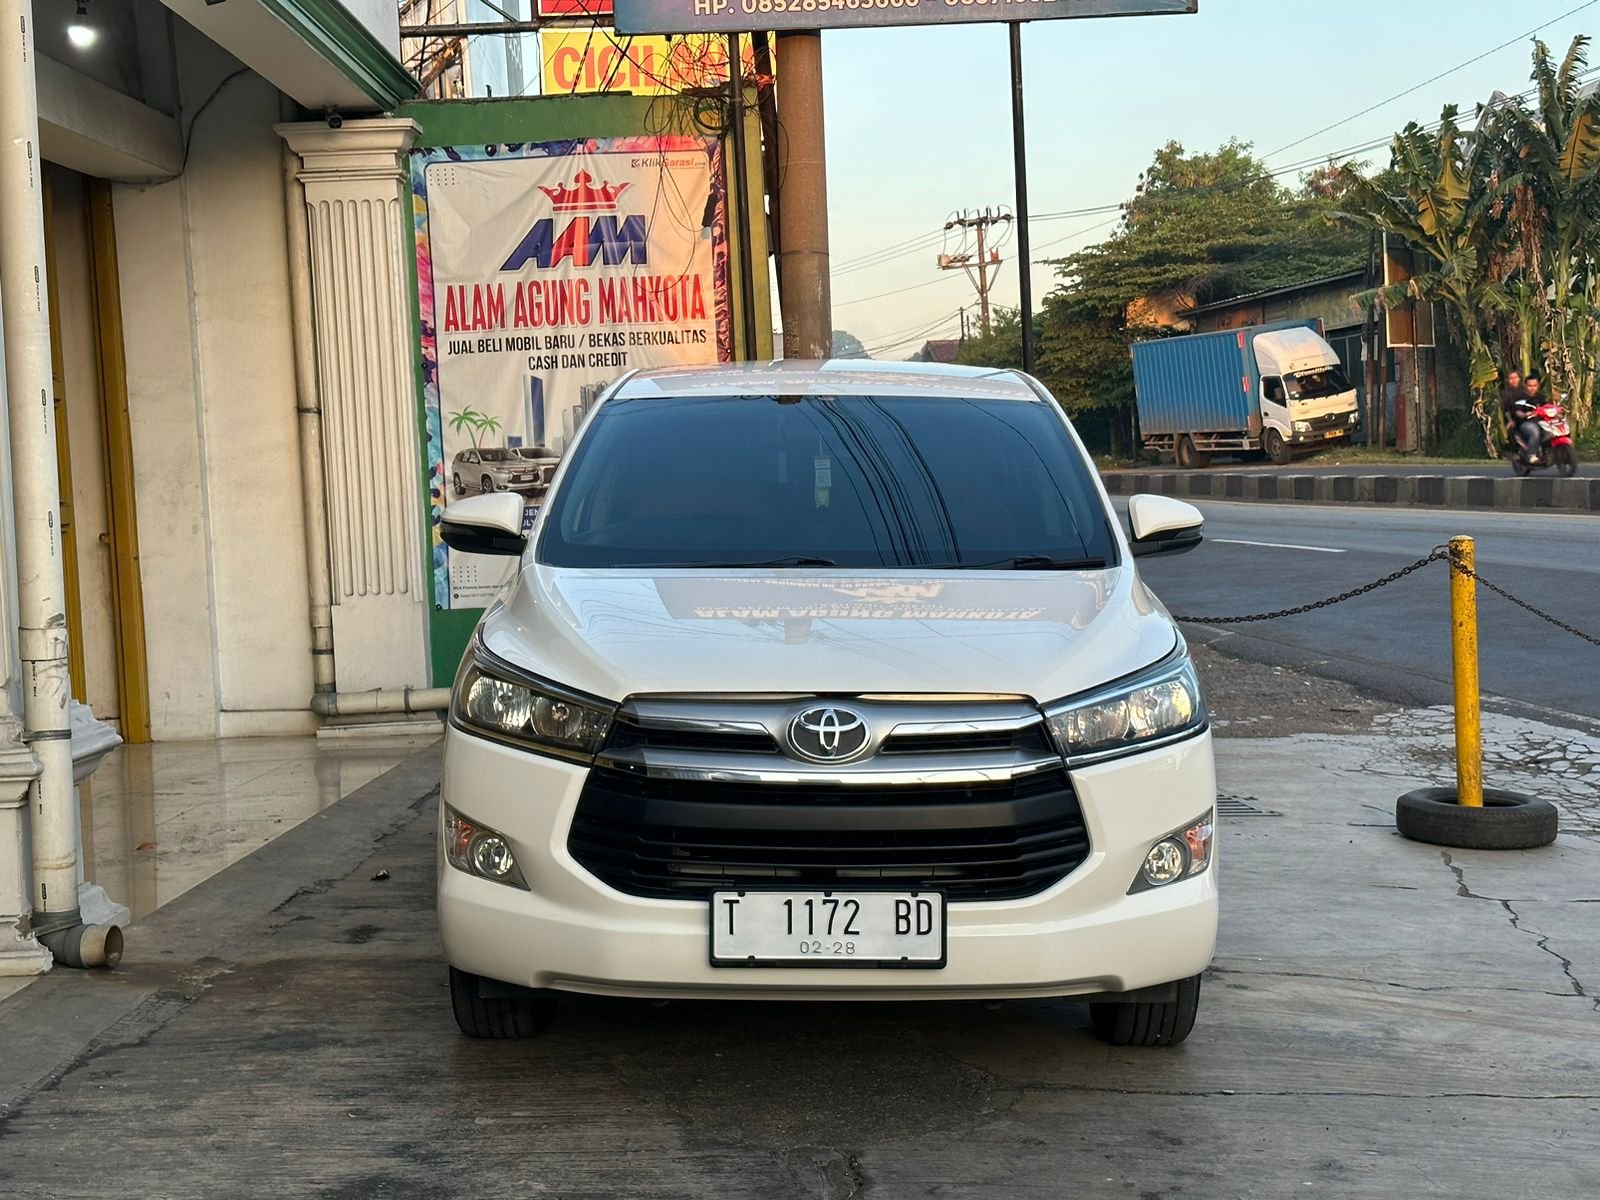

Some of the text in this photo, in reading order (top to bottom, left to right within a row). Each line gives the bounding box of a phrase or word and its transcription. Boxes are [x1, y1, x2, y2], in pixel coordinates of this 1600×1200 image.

[693, 0, 735, 15] HP.
[499, 215, 649, 272] AAM
[443, 273, 706, 334] ALAM AGUNG MAHKOTA
[448, 338, 475, 355] JUAL
[478, 336, 503, 353] BELI
[505, 334, 542, 352] MOBIL
[544, 333, 576, 351] BARU
[588, 332, 626, 348] BEKAS
[628, 329, 707, 347] BERKUALITAS
[528, 351, 628, 371] CASH DAN CREDIT
[722, 898, 933, 936] T 1172 BD
